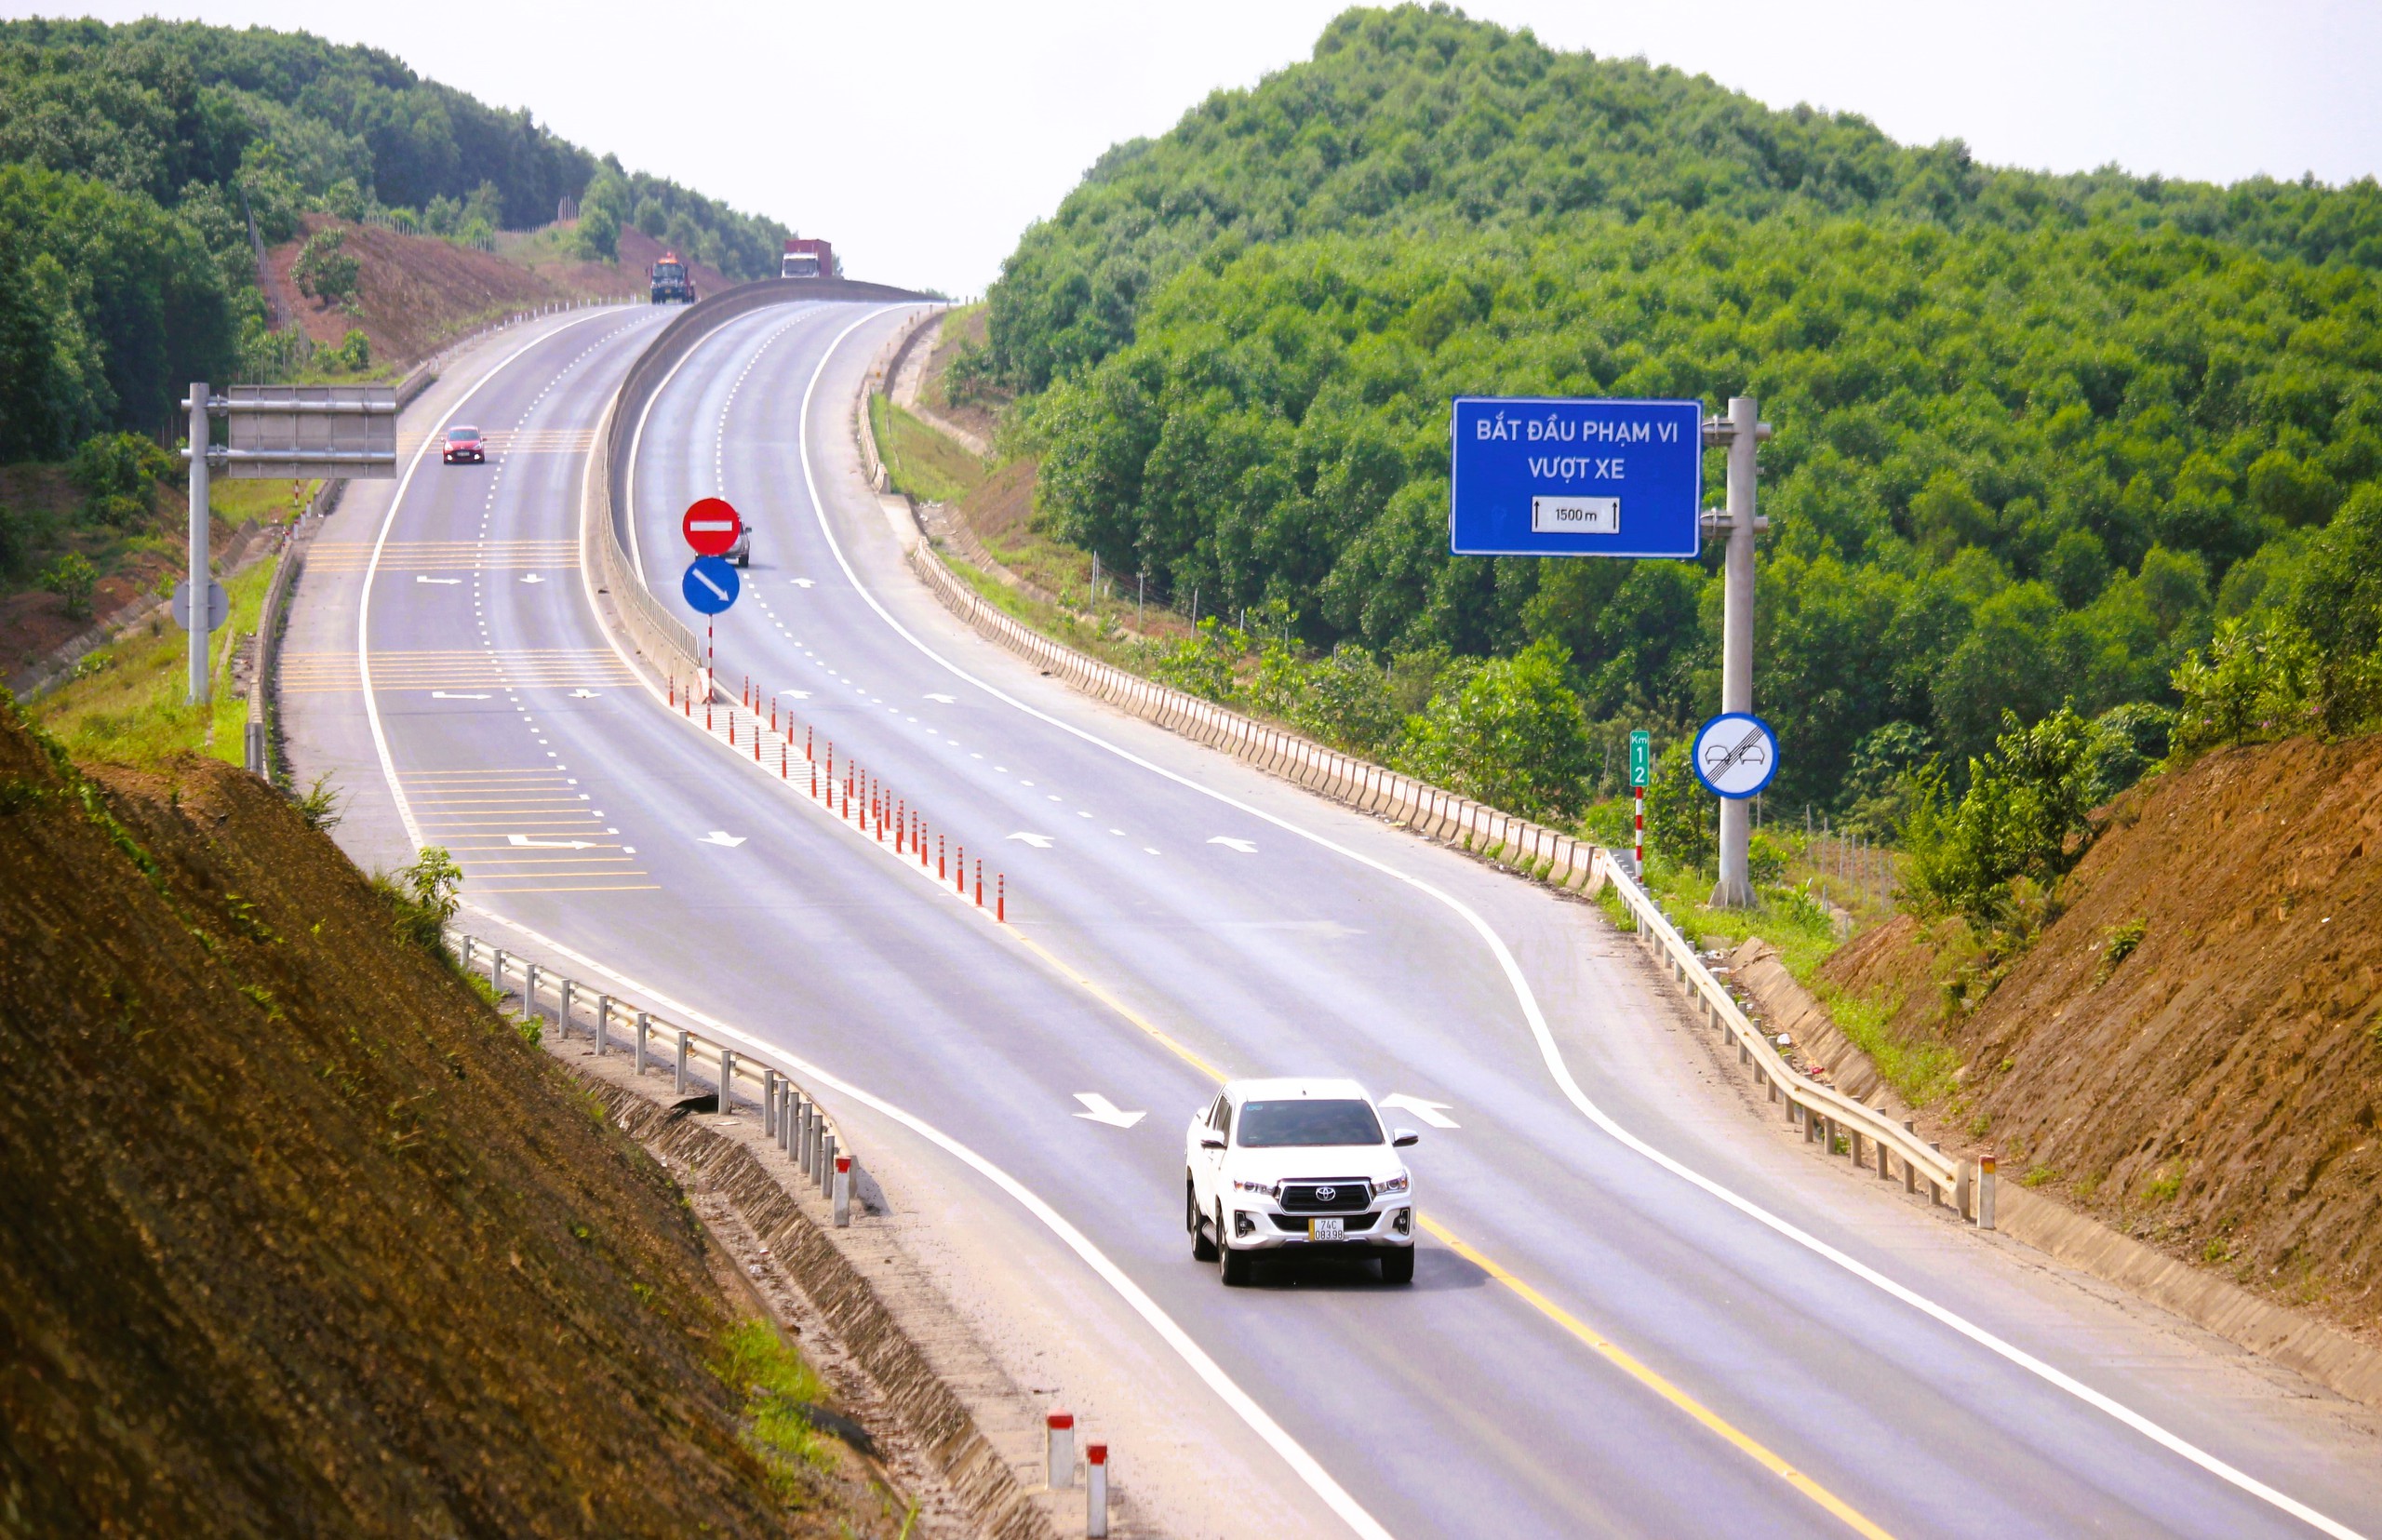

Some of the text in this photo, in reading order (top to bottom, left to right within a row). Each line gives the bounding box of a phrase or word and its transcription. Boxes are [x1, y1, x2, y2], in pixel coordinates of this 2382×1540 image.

[1477, 410, 1678, 447] BẮT ĐẦU PHẠM VI
[1528, 456, 1625, 484] VƯỢT XE
[1556, 509, 1597, 521] 1500 m
[1631, 736, 1647, 744] Km
[1320, 1220, 1336, 1229] 74C
